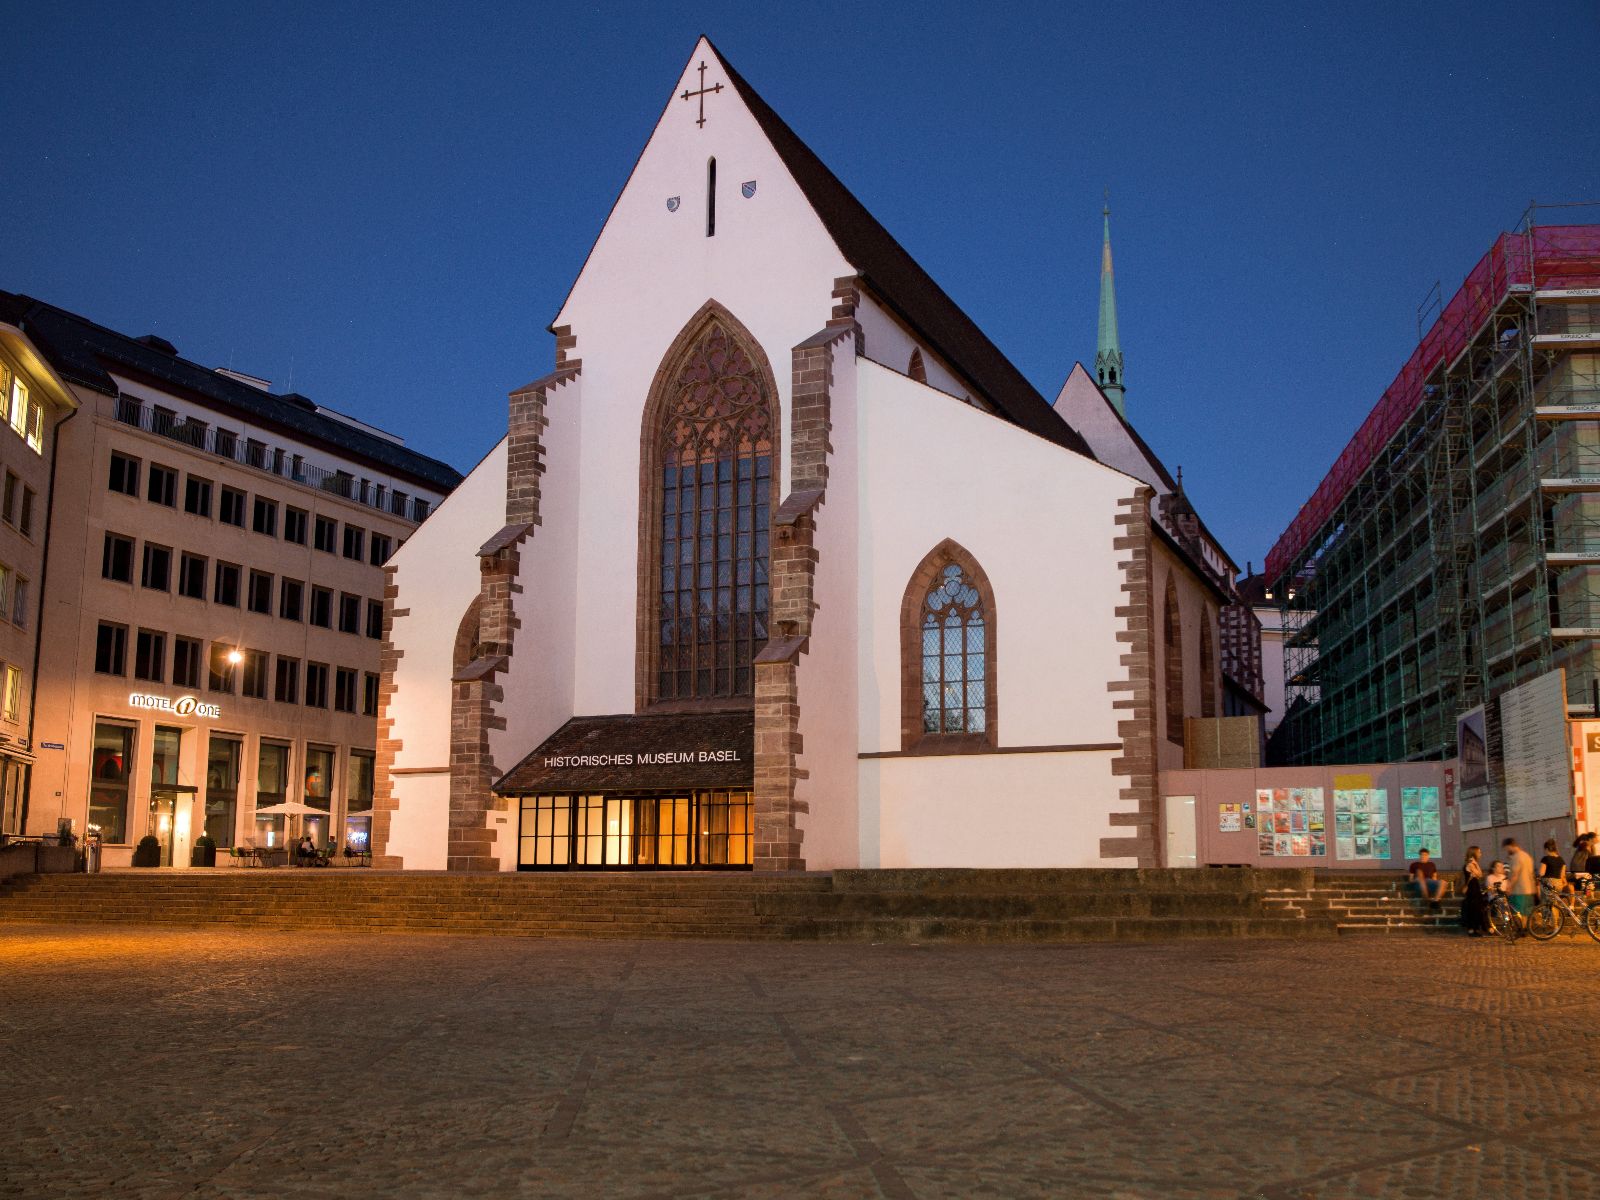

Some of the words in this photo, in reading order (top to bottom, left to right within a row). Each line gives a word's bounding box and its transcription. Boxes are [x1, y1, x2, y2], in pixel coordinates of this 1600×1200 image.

[544, 754, 633, 768] HISTORISCHES
[637, 751, 694, 765] MUSEUM
[698, 750, 741, 763] BASEL
